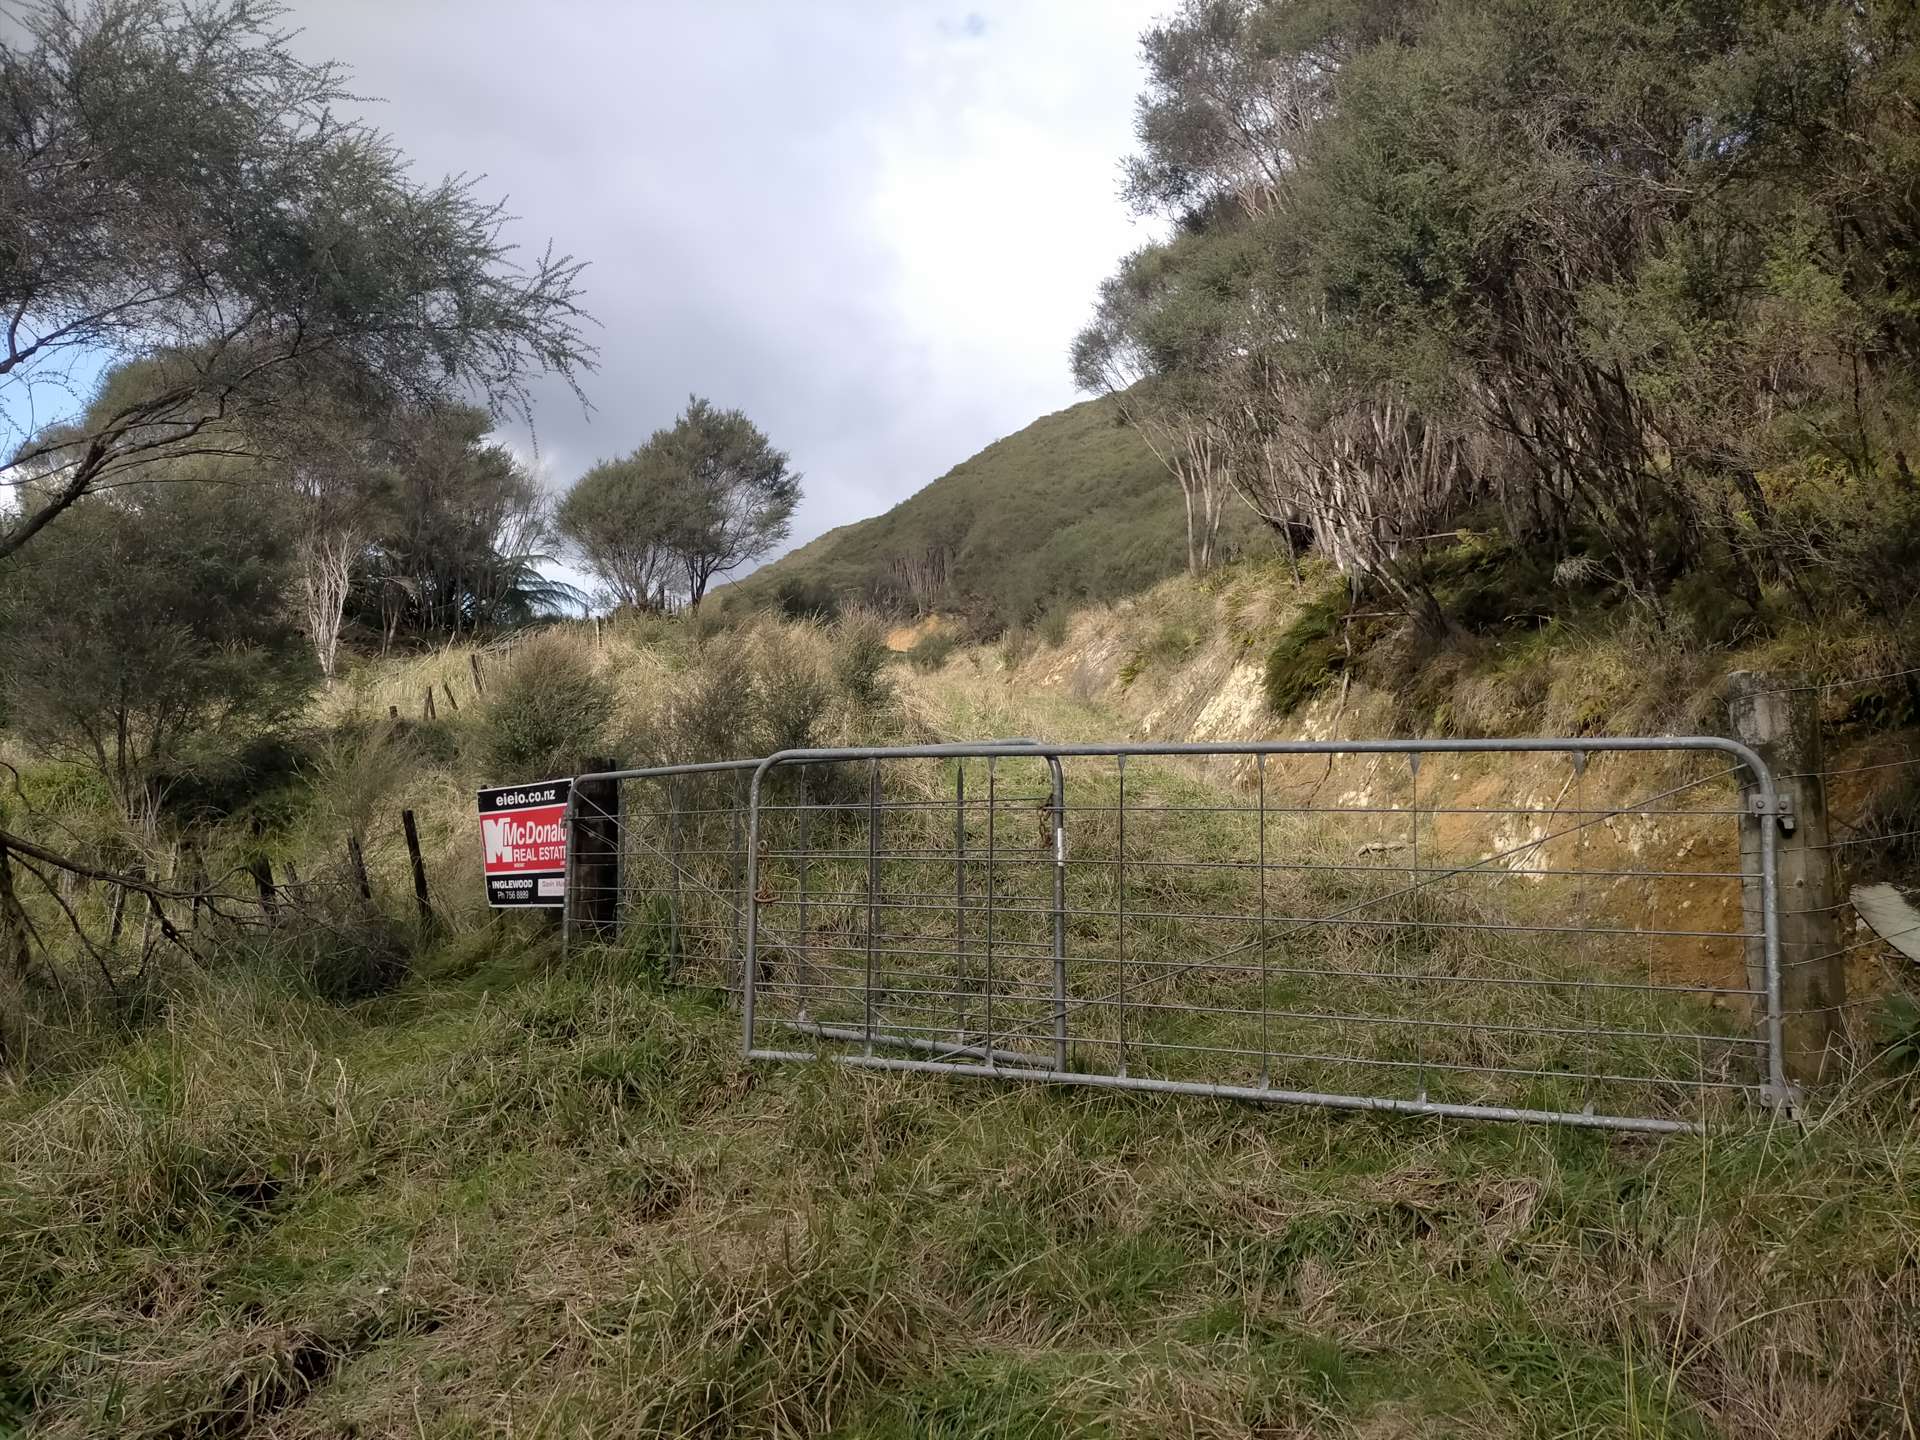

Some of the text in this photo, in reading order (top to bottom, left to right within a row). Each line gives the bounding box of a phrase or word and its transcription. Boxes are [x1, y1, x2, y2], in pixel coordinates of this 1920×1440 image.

[496, 789, 556, 806] eieio.co.nz
[513, 849, 537, 862] REAL
[492, 880, 533, 889] INGLEWOOD
[497, 891, 505, 900] Ph
[505, 890, 516, 900] 756
